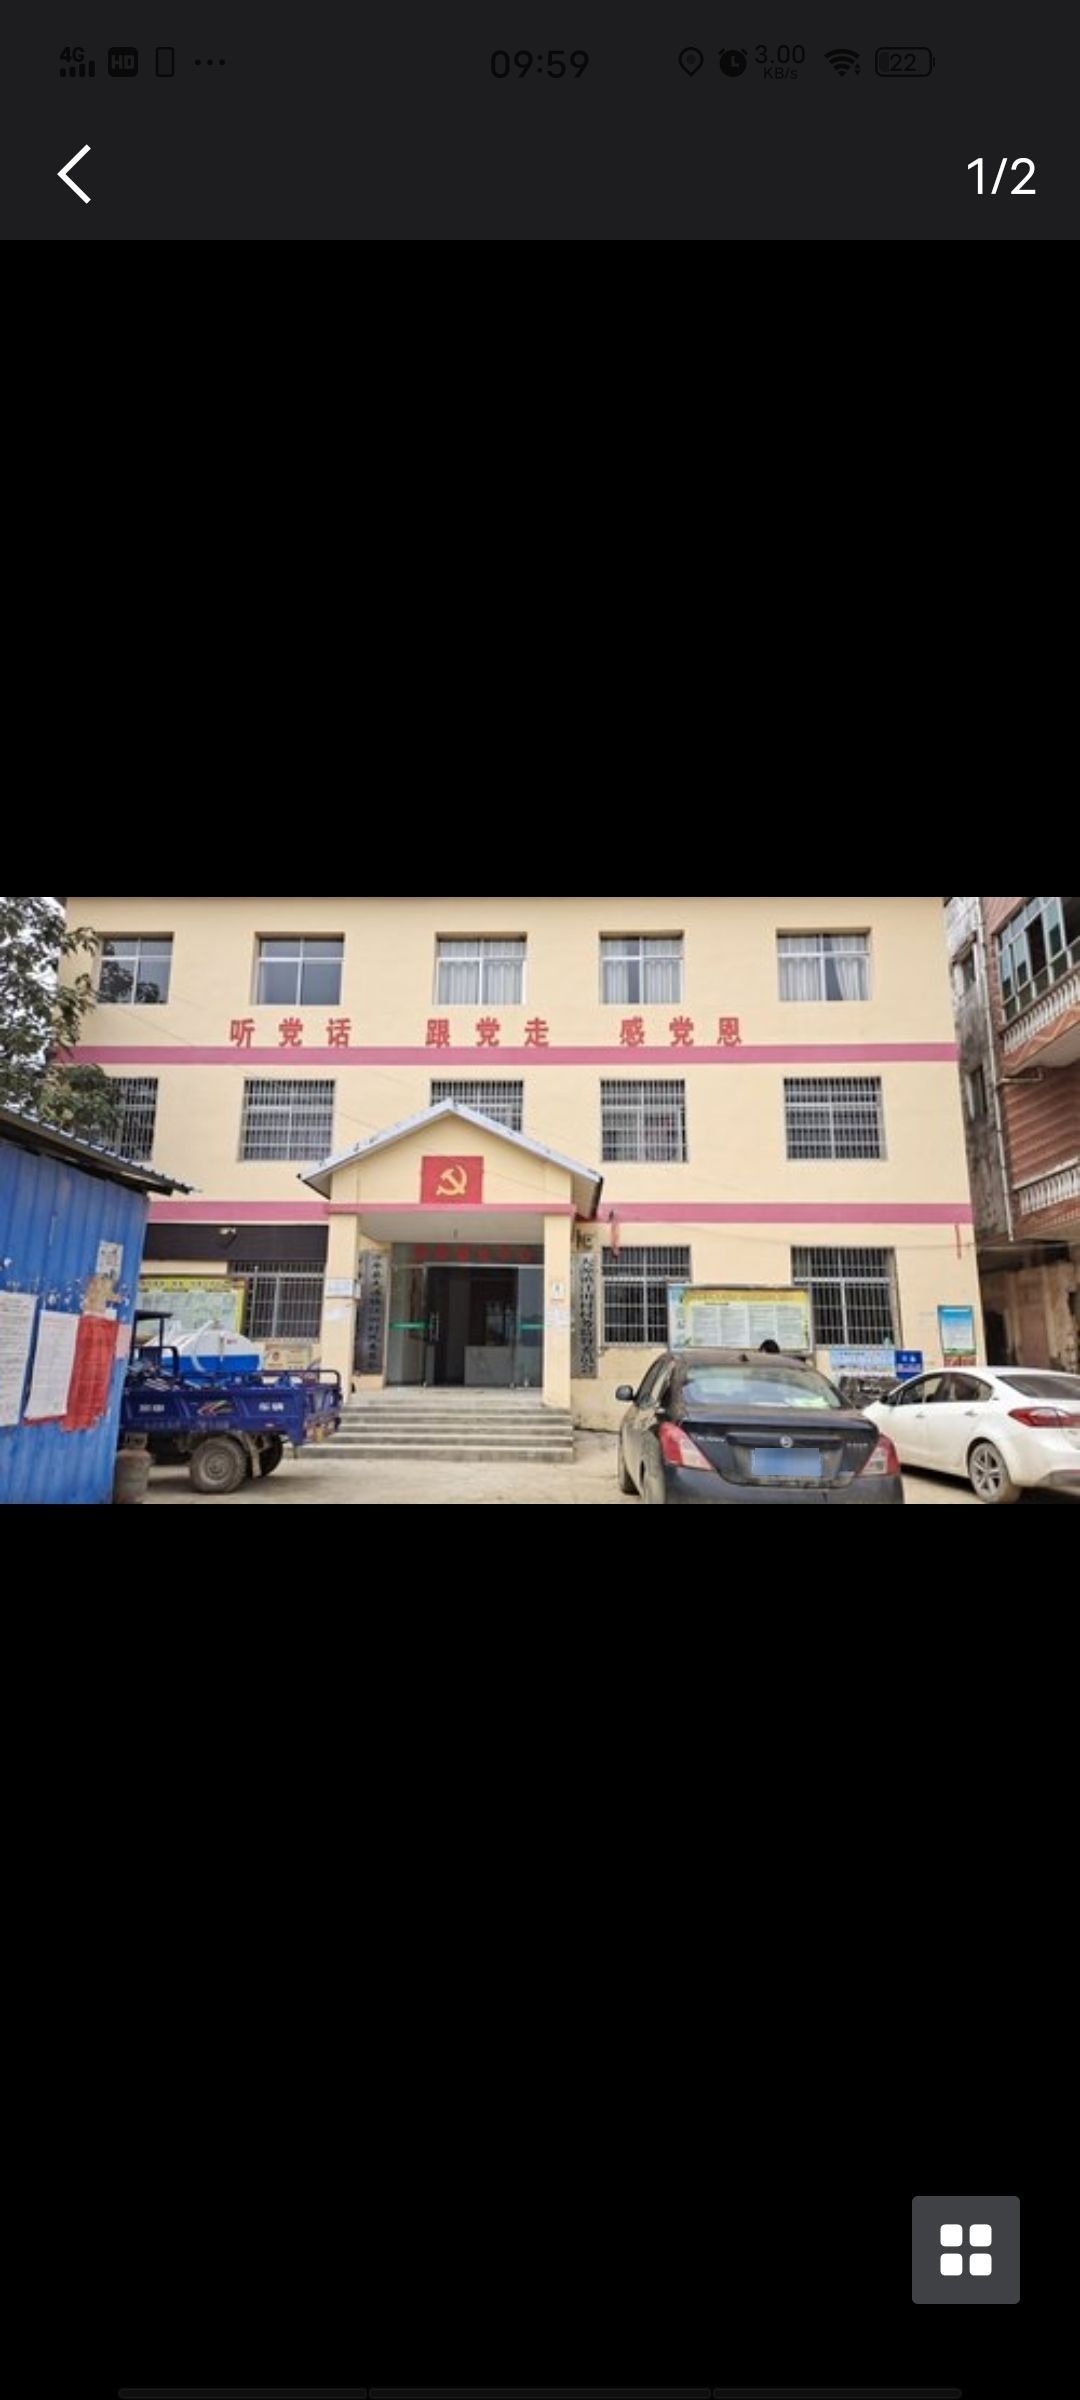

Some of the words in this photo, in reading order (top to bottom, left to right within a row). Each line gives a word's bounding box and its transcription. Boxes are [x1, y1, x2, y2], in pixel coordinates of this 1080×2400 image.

[229, 1016, 352, 1047] 听党话
[425, 1016, 550, 1047] 跟党走
[619, 1015, 743, 1046] 感党恩
